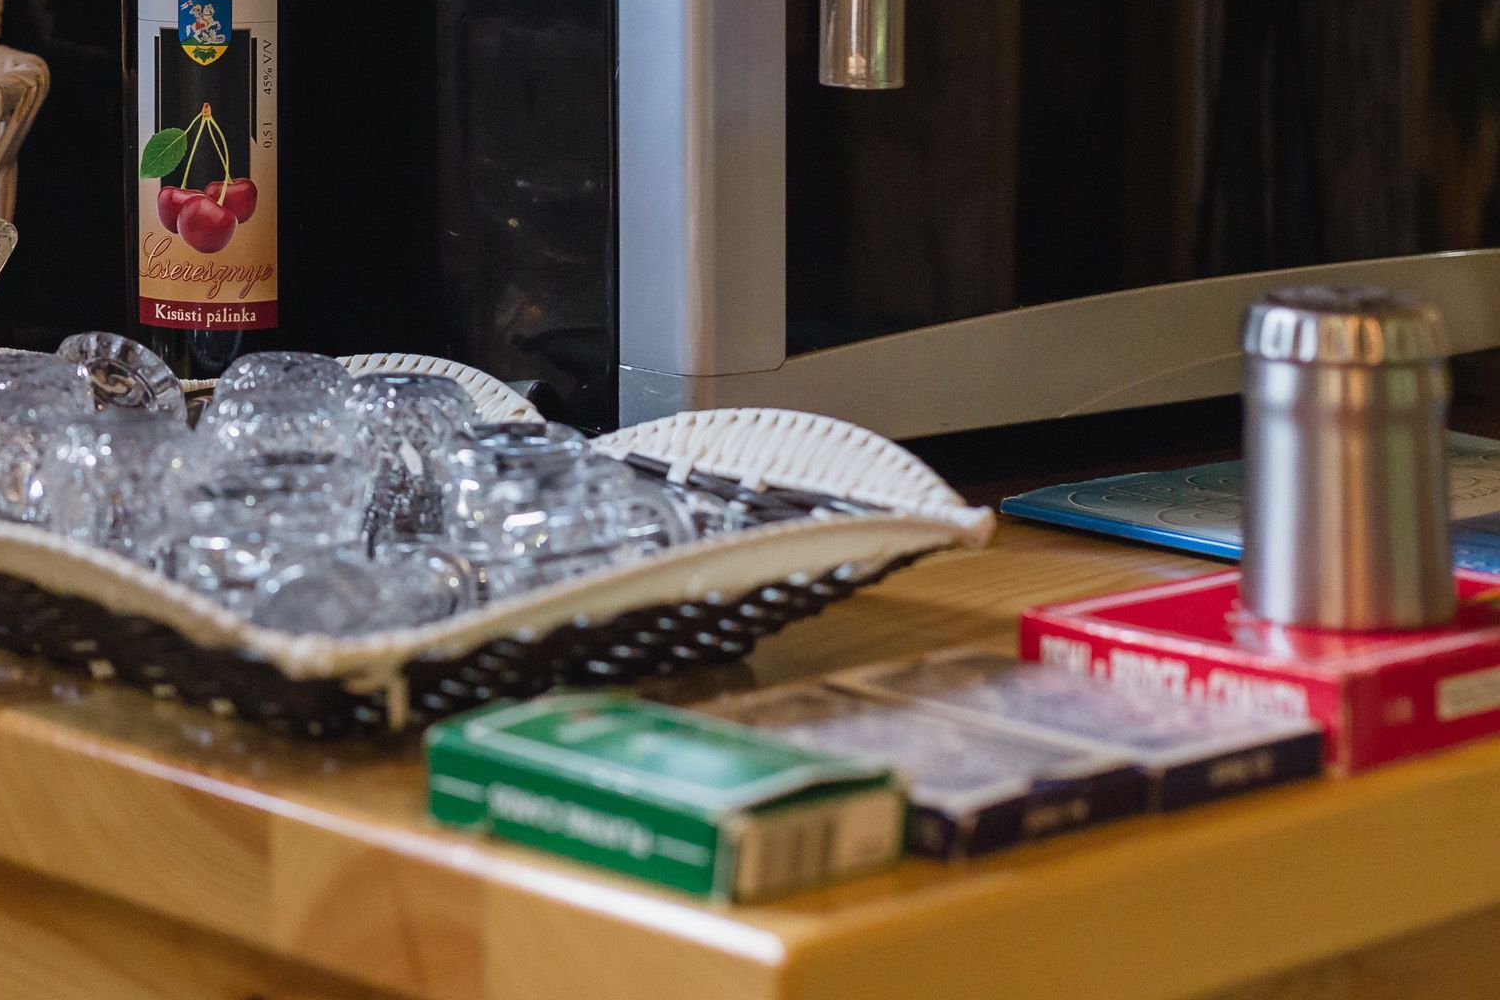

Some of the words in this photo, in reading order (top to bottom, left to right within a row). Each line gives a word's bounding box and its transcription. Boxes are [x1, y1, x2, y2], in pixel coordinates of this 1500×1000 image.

[263, 67, 273, 96] 45%
[139, 231, 274, 300] Cseresznye
[154, 303, 202, 322] Kisüsti
[206, 307, 257, 328] pálinka
